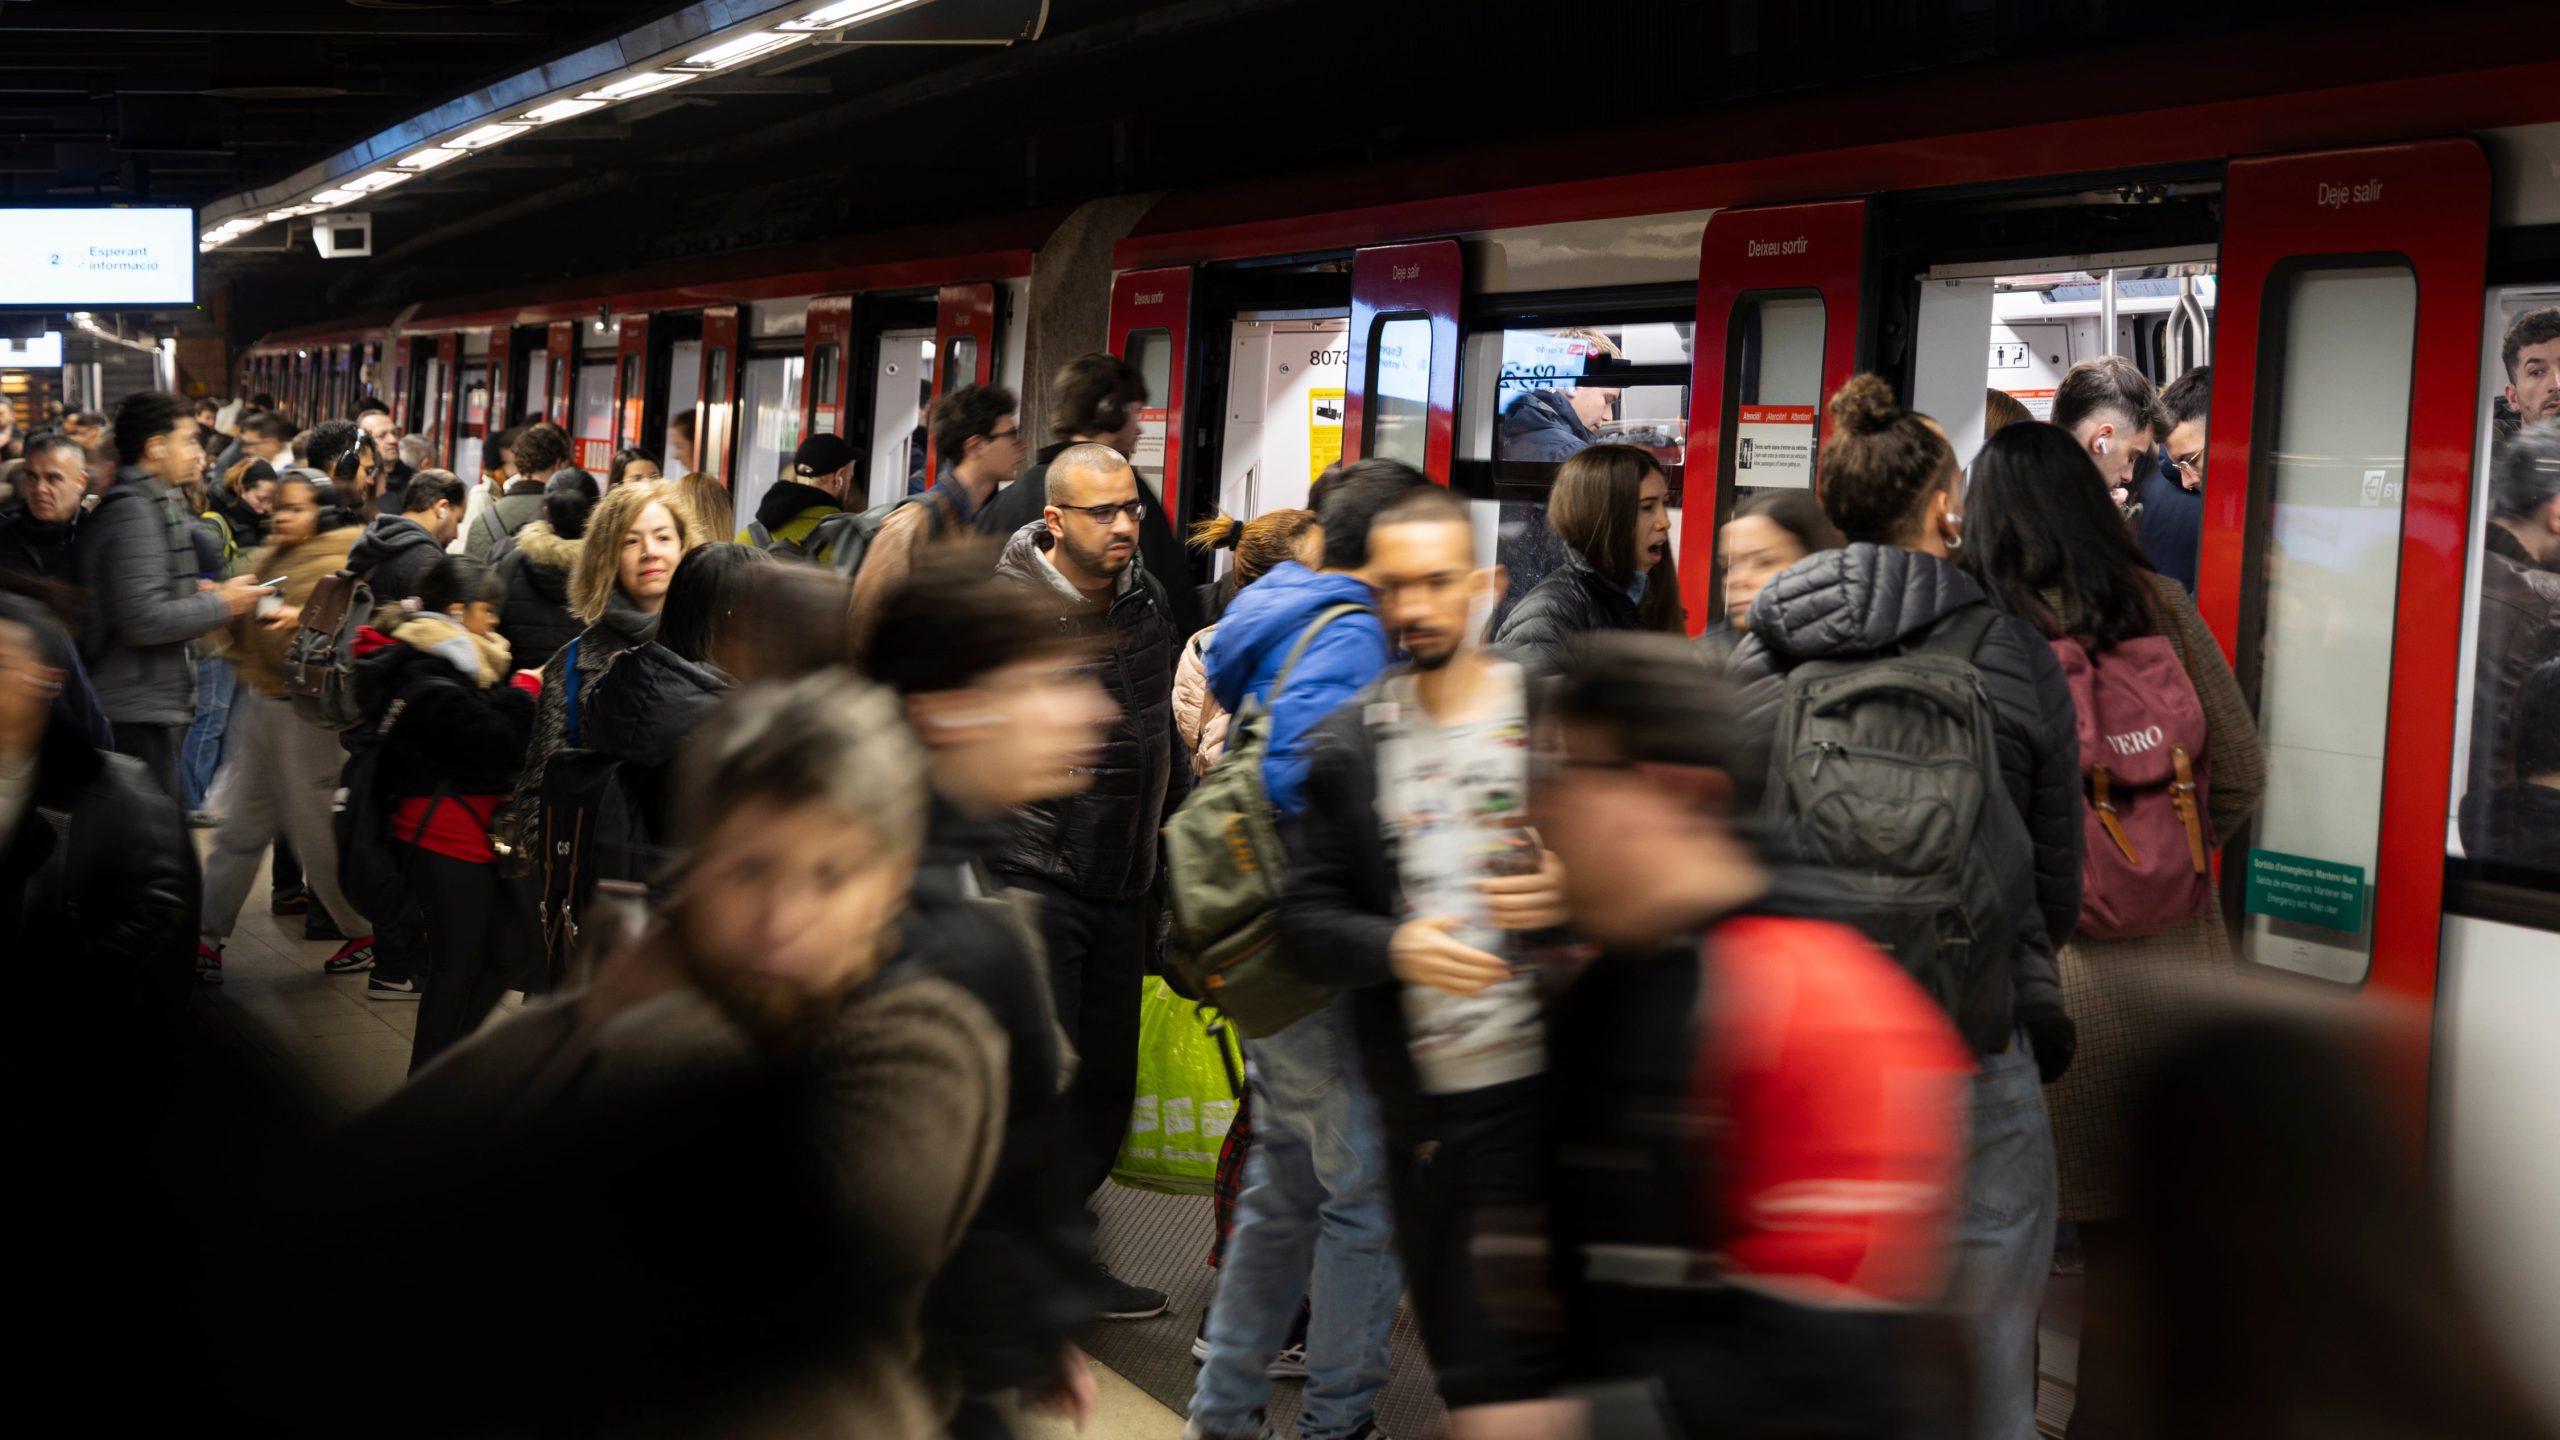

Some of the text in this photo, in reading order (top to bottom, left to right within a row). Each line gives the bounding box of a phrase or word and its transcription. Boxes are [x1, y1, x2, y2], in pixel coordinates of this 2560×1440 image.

[2318, 178, 2383, 210] Deje salir
[89, 246, 148, 258] Esperant
[1748, 235, 1808, 257] Deixeu sortir
[51, 254, 59, 265] 2
[89, 259, 159, 271] informació
[1392, 263, 1420, 283] Deje salir
[2105, 725, 2163, 755] VERO
